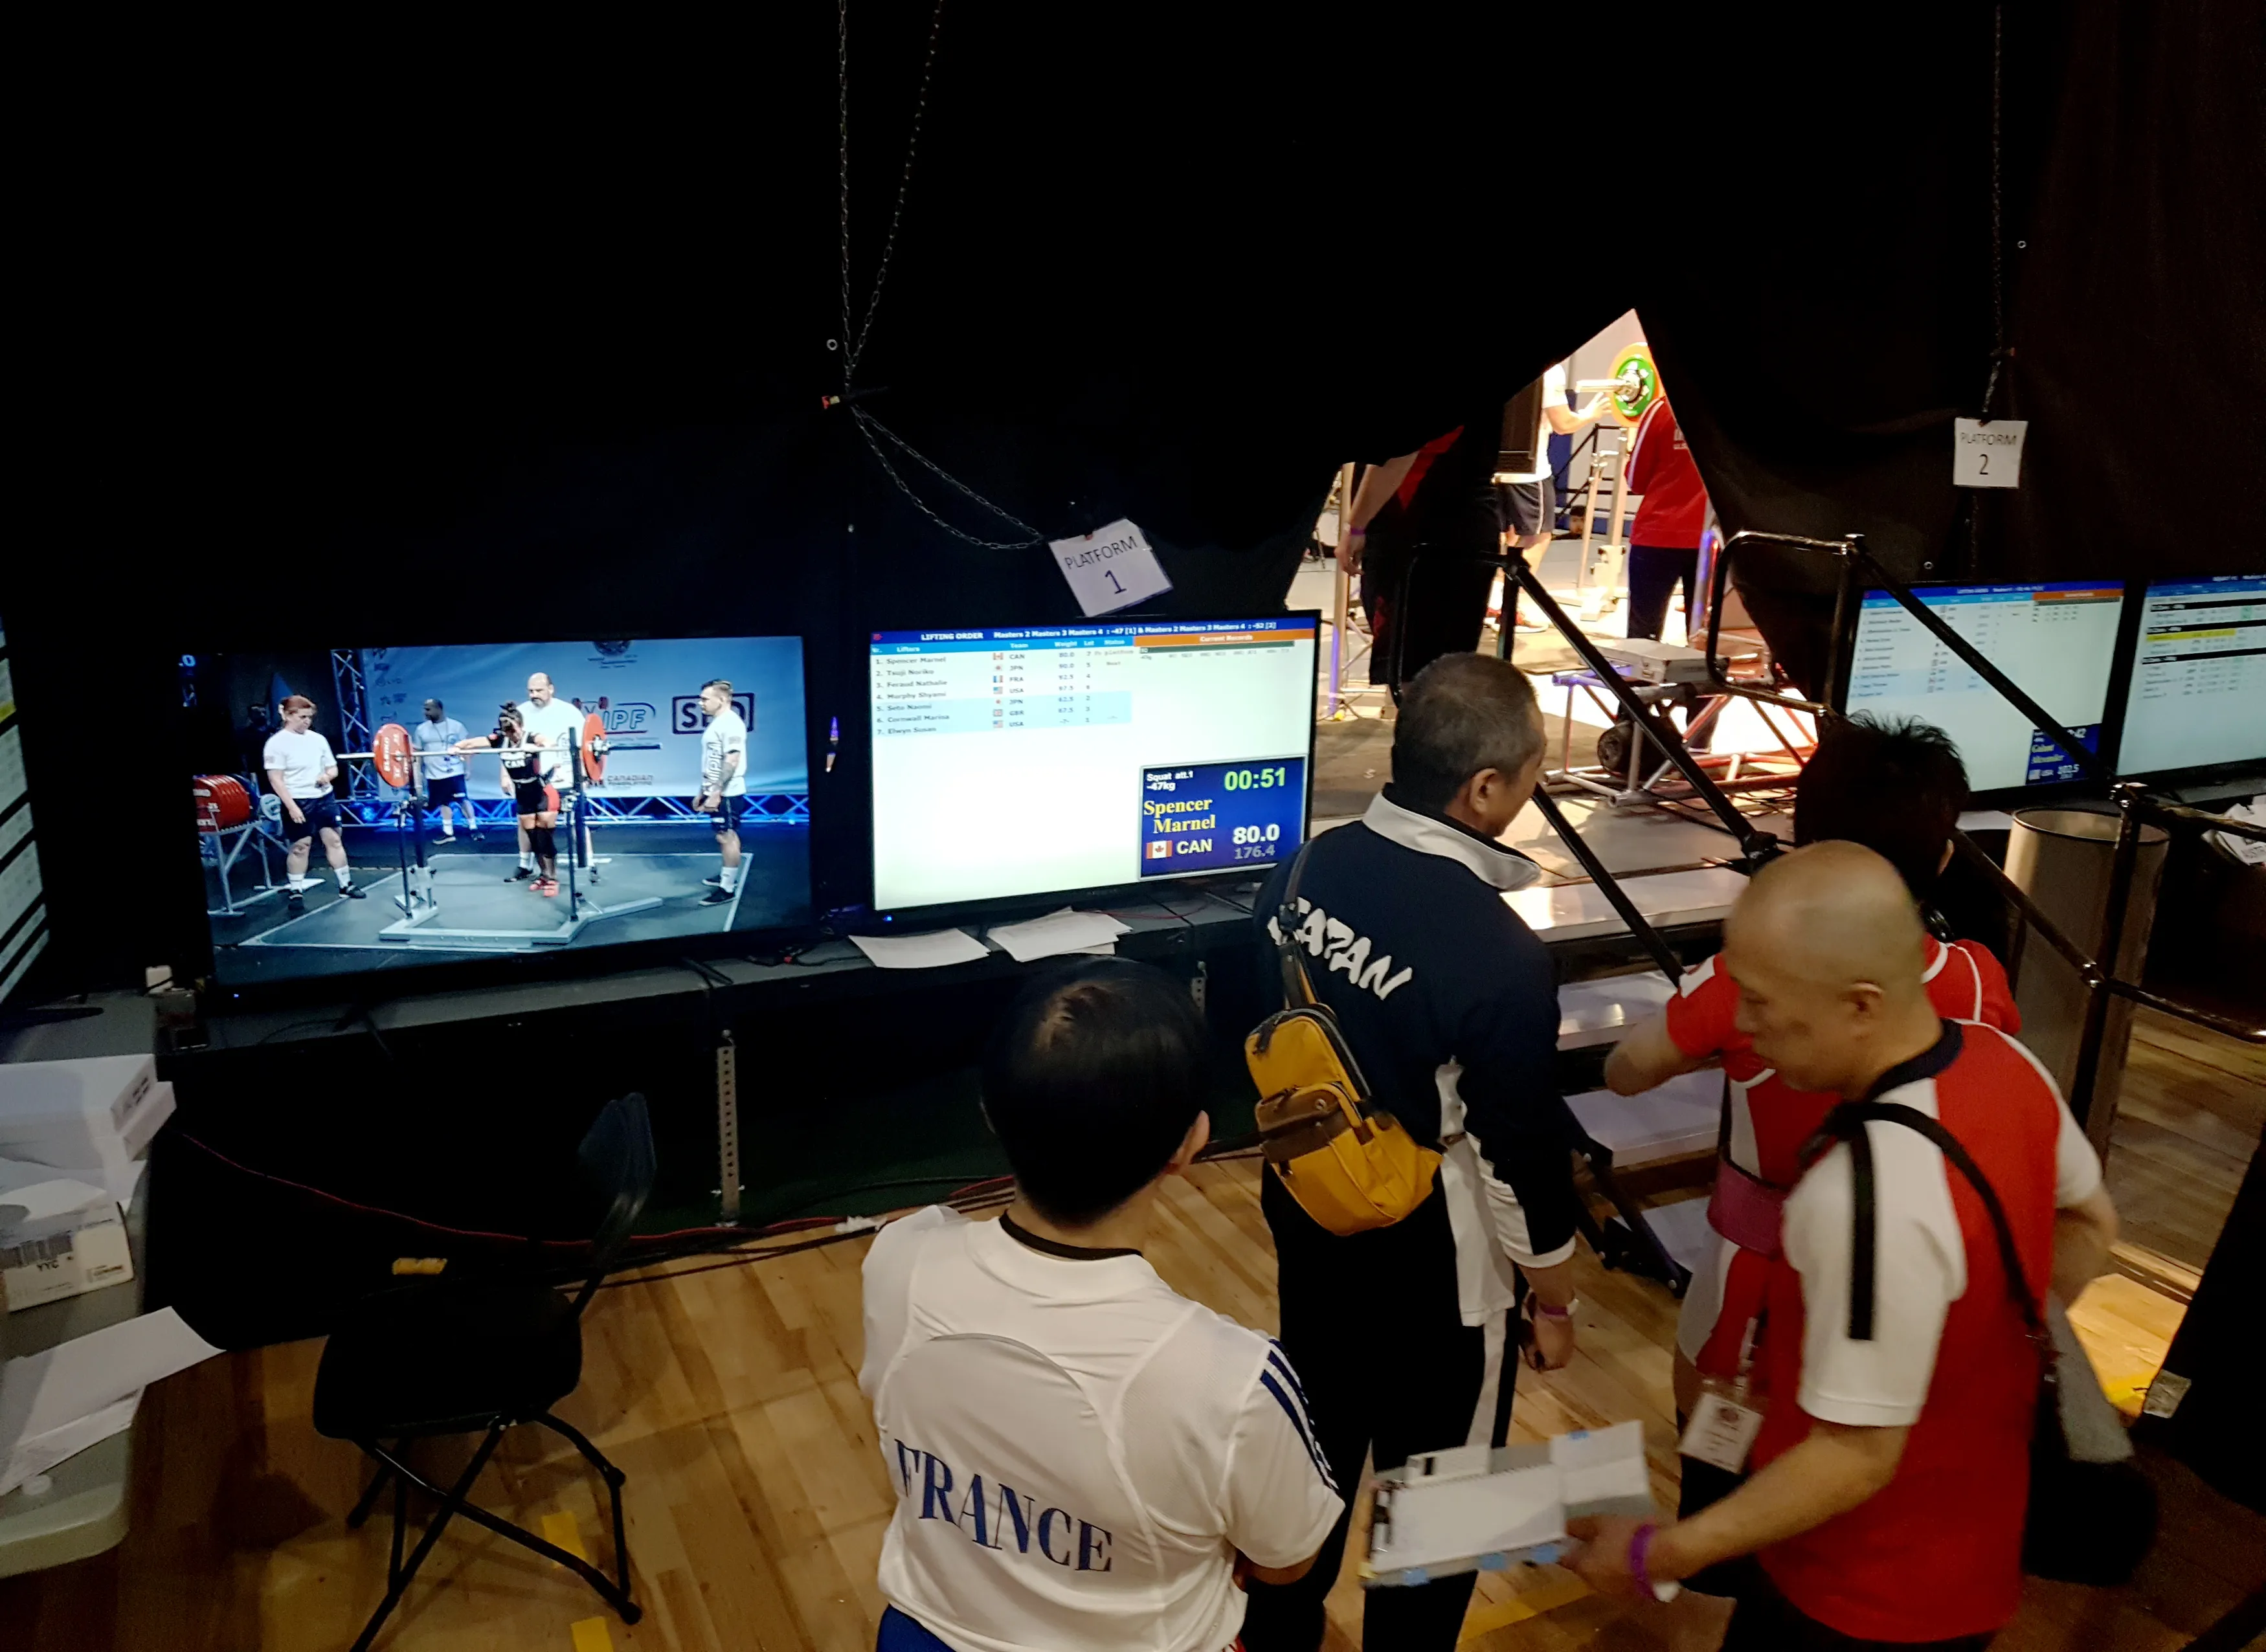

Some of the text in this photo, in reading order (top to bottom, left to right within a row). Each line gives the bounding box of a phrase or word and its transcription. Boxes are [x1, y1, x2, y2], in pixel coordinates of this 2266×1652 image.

[1960, 432, 2017, 445] PLATFORM
[1979, 454, 1988, 475] 2
[1064, 535, 1138, 570] PLATFORM
[1105, 570, 1127, 594] 1
[603, 708, 647, 731] IPF
[1147, 770, 1194, 783] Squat att.1
[1147, 781, 1176, 792] -47kg
[1224, 767, 1285, 791] 00:51
[1143, 799, 1213, 818] Spencer
[1153, 814, 1216, 834] Marnel
[1233, 823, 1281, 845] 80.0
[1176, 838, 1213, 854] CAN
[1234, 844, 1276, 860] 176.4
[894, 1438, 1113, 1573] FRANCE
